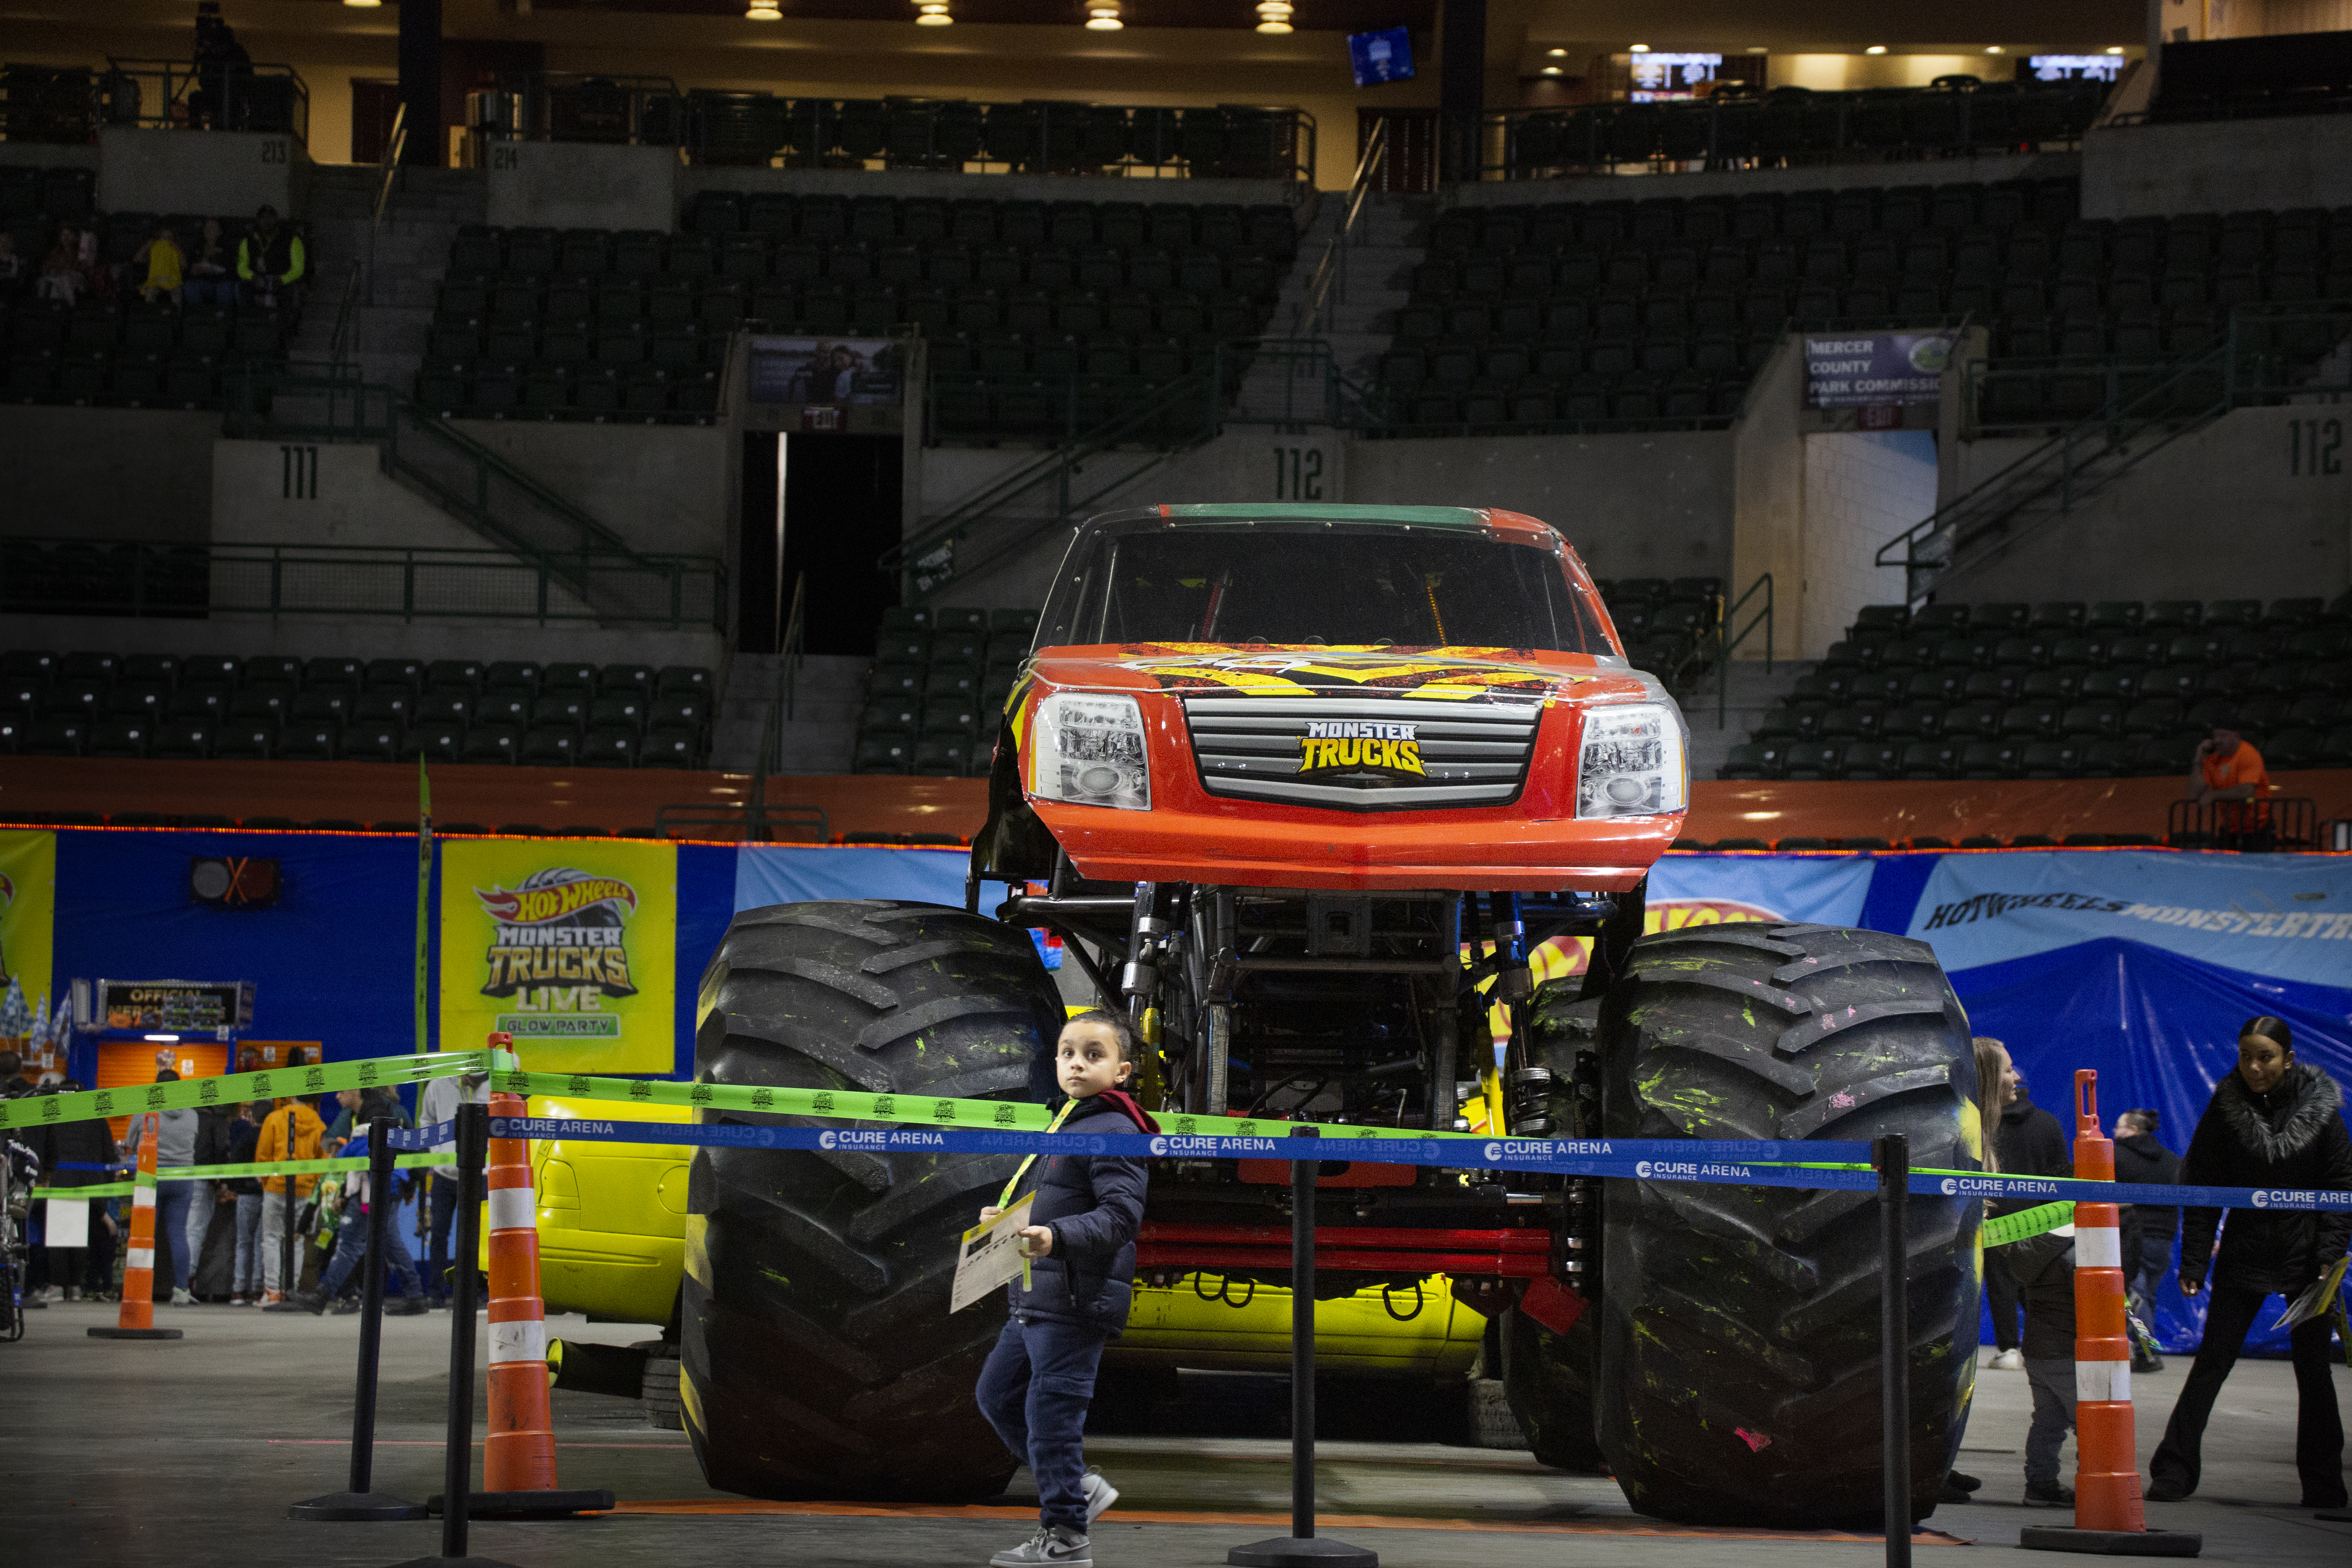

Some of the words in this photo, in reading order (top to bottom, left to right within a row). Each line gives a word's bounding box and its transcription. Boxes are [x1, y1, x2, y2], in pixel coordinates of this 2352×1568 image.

[262, 141, 286, 164] 213
[494, 147, 518, 170] 214
[1810, 340, 1873, 354] MERCER
[1810, 360, 1872, 374] COUNTY
[1810, 380, 1850, 393] PARK
[2289, 418, 2342, 476] 112
[281, 445, 317, 499] 111
[1274, 447, 1324, 500] 112
[1307, 722, 1419, 740] MONSTER
[1298, 738, 1427, 777] TRUCKS
[516, 888, 560, 921] HOT
[2118, 903, 2352, 940] MONSTERTR
[496, 926, 625, 946] MONSTER
[487, 946, 636, 990] TRUCKS
[516, 986, 602, 1012] LIVE
[507, 1019, 552, 1033] GLOW
[554, 1018, 610, 1033] PARTY
[509, 1119, 556, 1131] CURE
[561, 1121, 614, 1134] ARENA
[838, 1131, 886, 1143] CURE
[890, 1132, 944, 1145] ARENA
[1170, 1137, 1217, 1149] CURE
[1221, 1138, 1275, 1150] ARENA
[1504, 1142, 1552, 1154] CURE
[1556, 1142, 1612, 1155] ARENA
[1653, 1161, 1697, 1175] CURE
[1701, 1164, 1751, 1177] ARENA
[1959, 1179, 2003, 1191] CURE
[2007, 1181, 2058, 1193] ARENA
[2270, 1191, 2315, 1202] CURE
